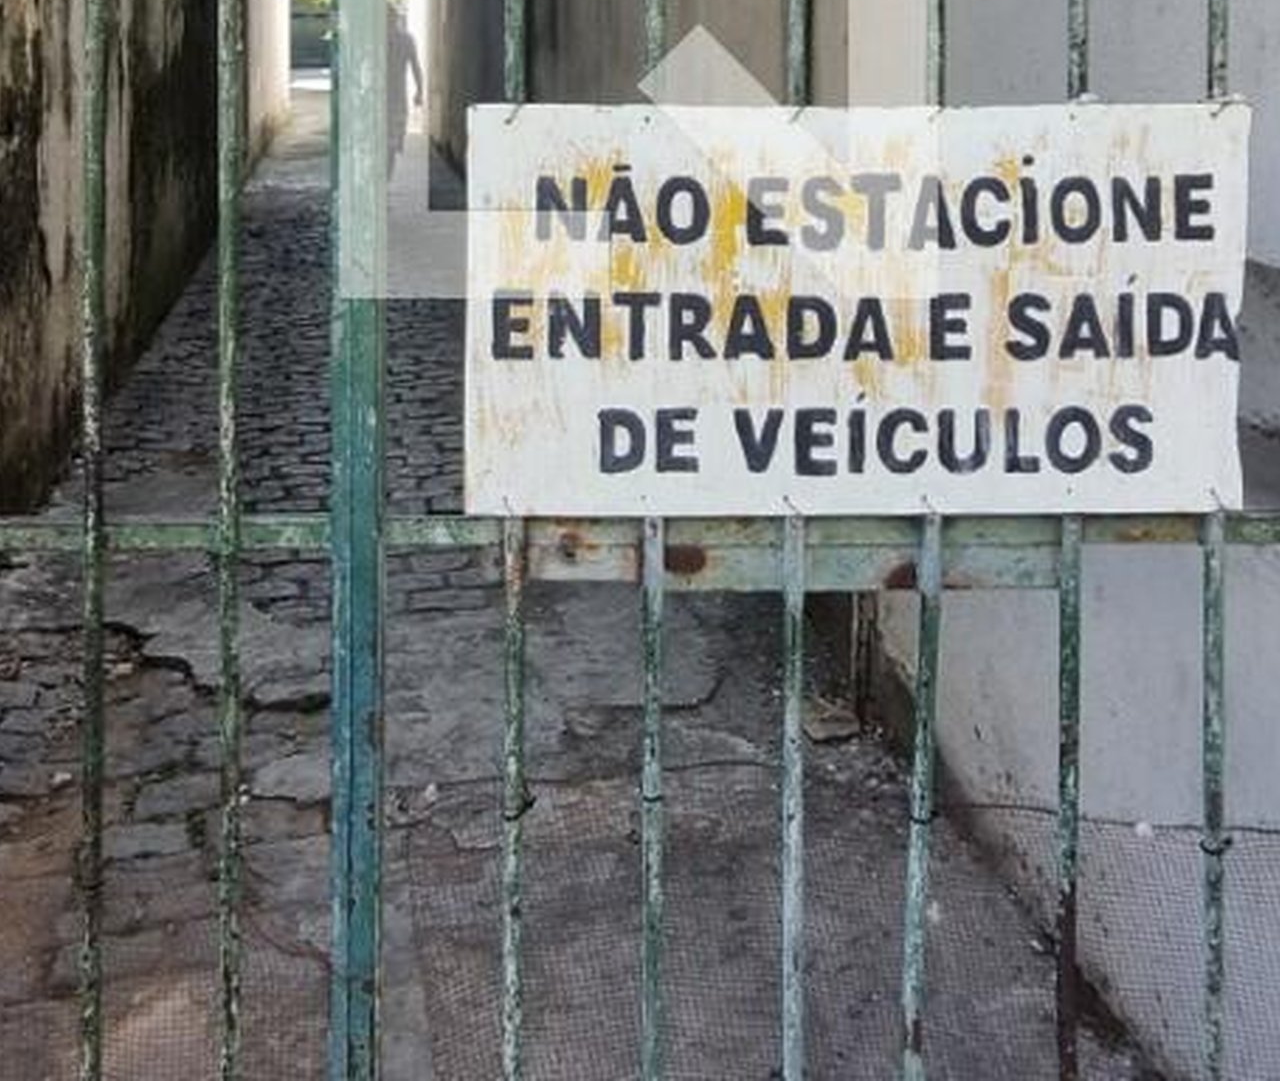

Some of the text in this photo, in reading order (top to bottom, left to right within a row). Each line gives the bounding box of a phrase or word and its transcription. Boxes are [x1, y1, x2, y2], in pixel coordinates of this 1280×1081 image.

[535, 156, 1214, 250] NÃO ESTACIONE
[492, 274, 1241, 362] ENTRADA E SAÍDA
[599, 394, 1154, 476] DE VEÍCULOS
